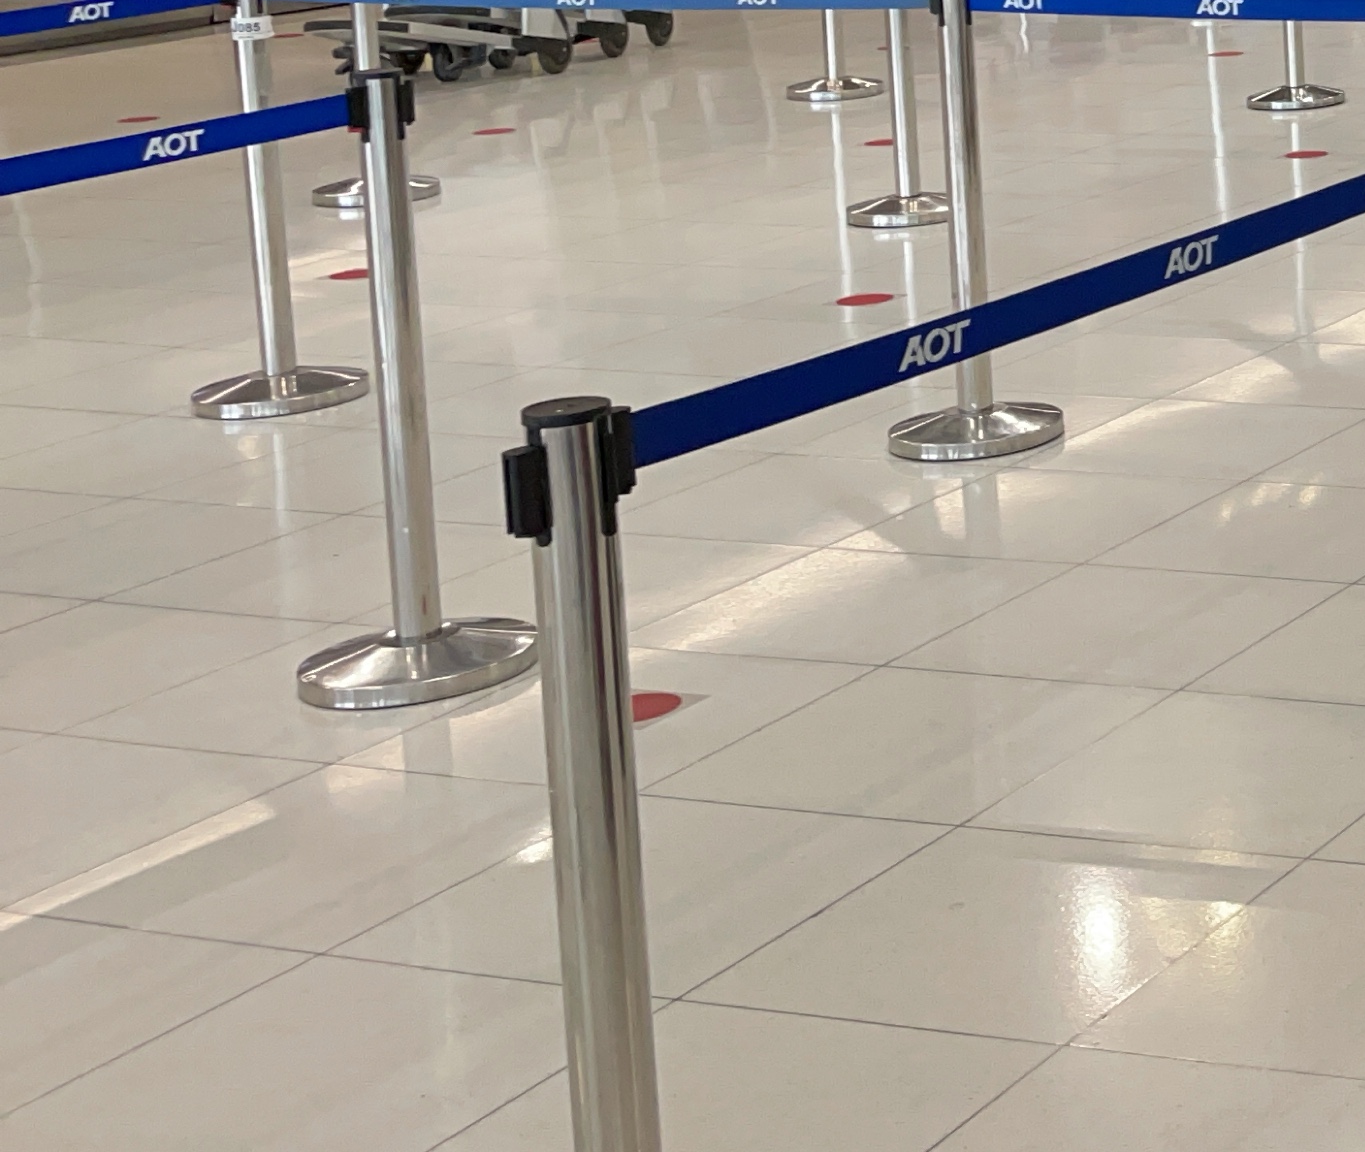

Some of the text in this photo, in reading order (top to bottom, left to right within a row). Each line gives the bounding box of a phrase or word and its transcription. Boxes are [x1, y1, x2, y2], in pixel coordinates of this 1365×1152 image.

[68, 1, 114, 23] AOT
[143, 128, 204, 161] AOT
[1164, 235, 1218, 280] AOT
[899, 318, 971, 373] AOT
